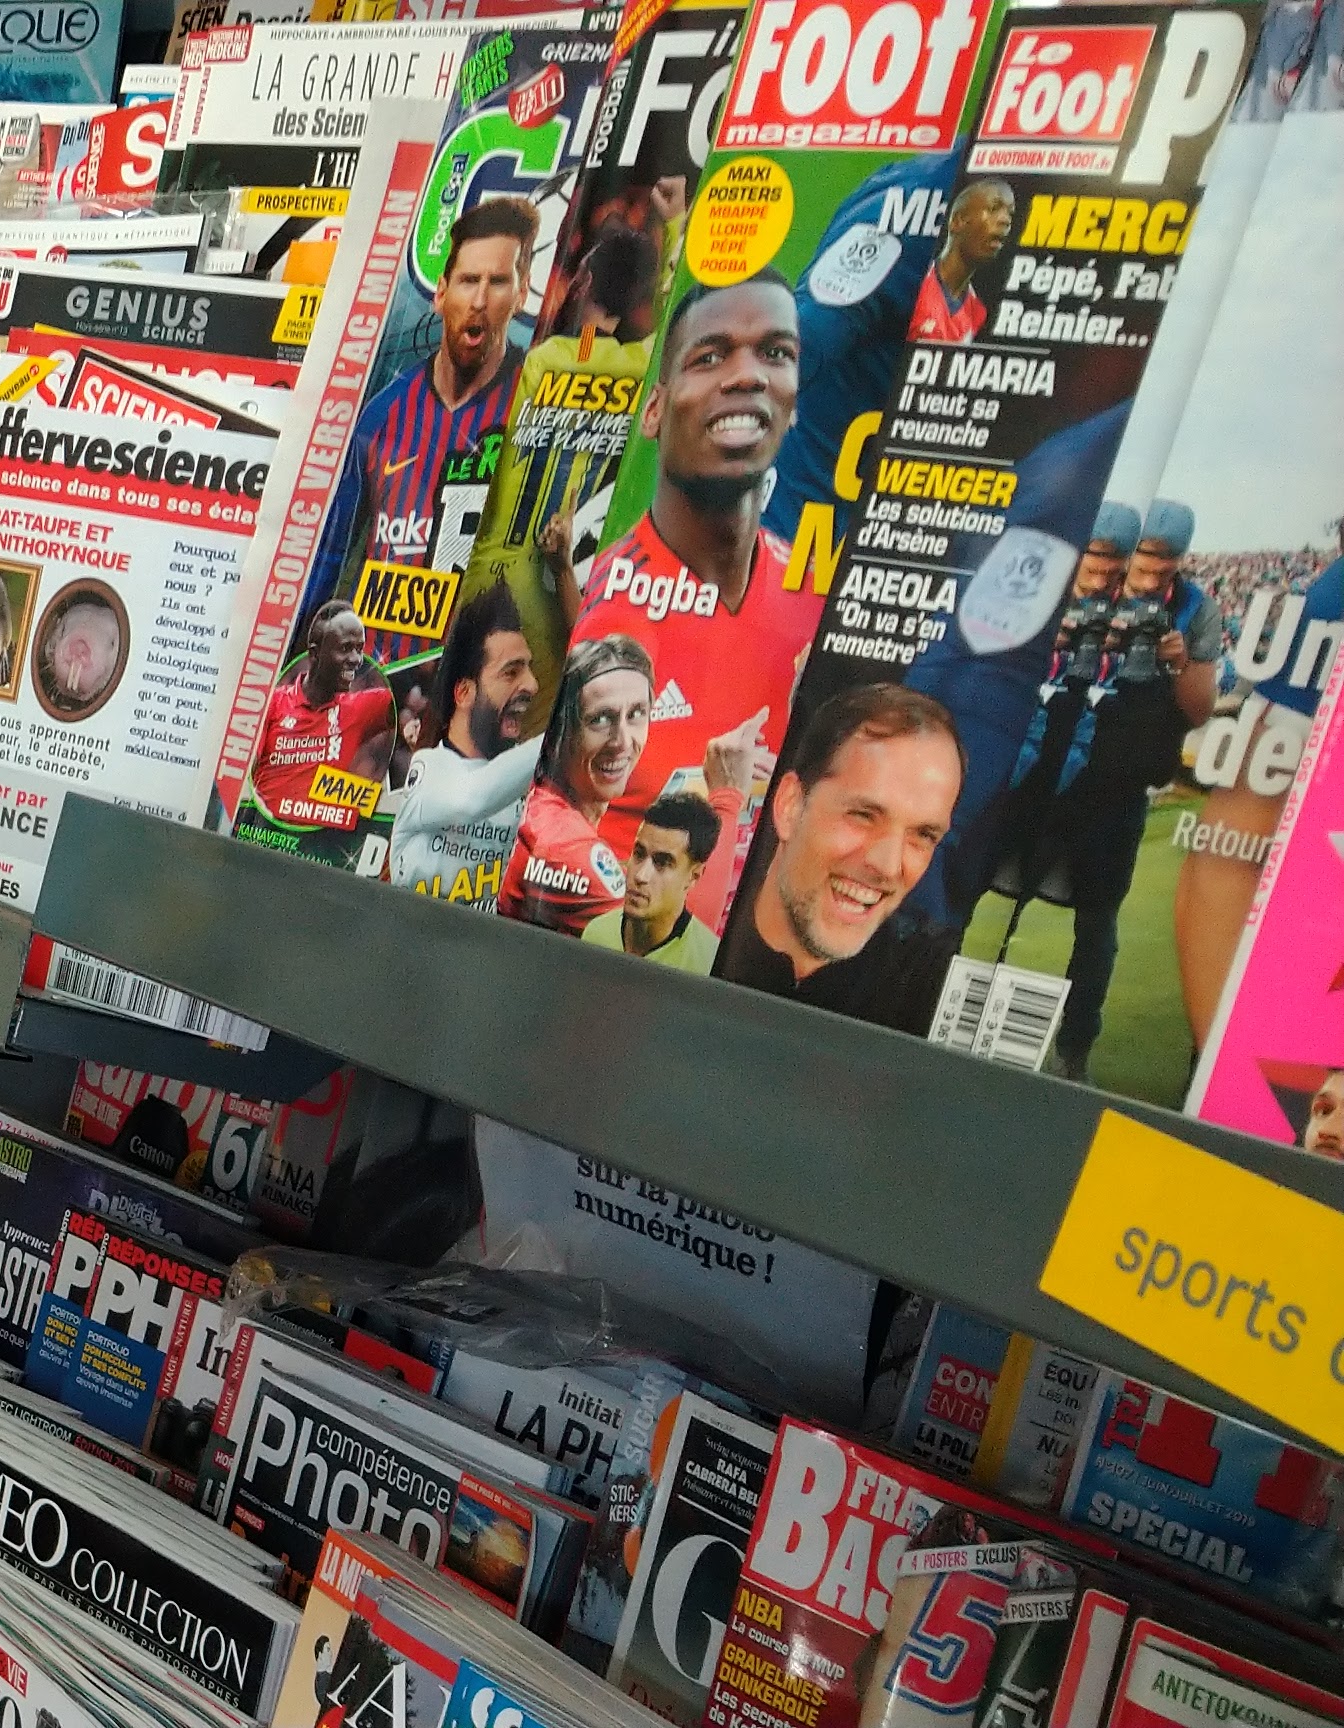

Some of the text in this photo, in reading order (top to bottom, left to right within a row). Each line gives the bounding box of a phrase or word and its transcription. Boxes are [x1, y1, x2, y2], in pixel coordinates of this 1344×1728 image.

[724, 122, 942, 148] magazine
[728, 165, 770, 182] MAXI
[257, 195, 334, 211] PROSPECTIVE
[708, 186, 782, 201] POSTERS
[66, 285, 212, 330] GENIUS
[142, 325, 205, 345] SCIENCE
[295, 395, 354, 485] VERS
[362, 190, 417, 305] MILAN
[906, 348, 1055, 396] DI MARIA
[916, 389, 968, 416] veut
[891, 416, 989, 448] revanche
[2, 468, 111, 500] science dans
[876, 458, 1017, 507] WENGER
[866, 494, 1005, 536] Les solutions
[174, 541, 236, 563] Pourquoi
[363, 569, 455, 629] MESSI
[604, 558, 720, 619] Pogba
[839, 564, 958, 614] AREOLA
[30, 722, 111, 752] apprennent
[36, 756, 90, 781] cancers
[16, 787, 48, 809] par
[315, 771, 375, 810] MANÉ
[524, 859, 590, 896] Modric
[128, 1136, 173, 1173] Canon
[1115, 1225, 1308, 1355] sports
[316, 1421, 450, 1513] compétence
[70, 1549, 248, 1689] COLLECTION
[737, 1589, 784, 1631] NBA
[717, 1667, 818, 1728] DUNKERQUE
